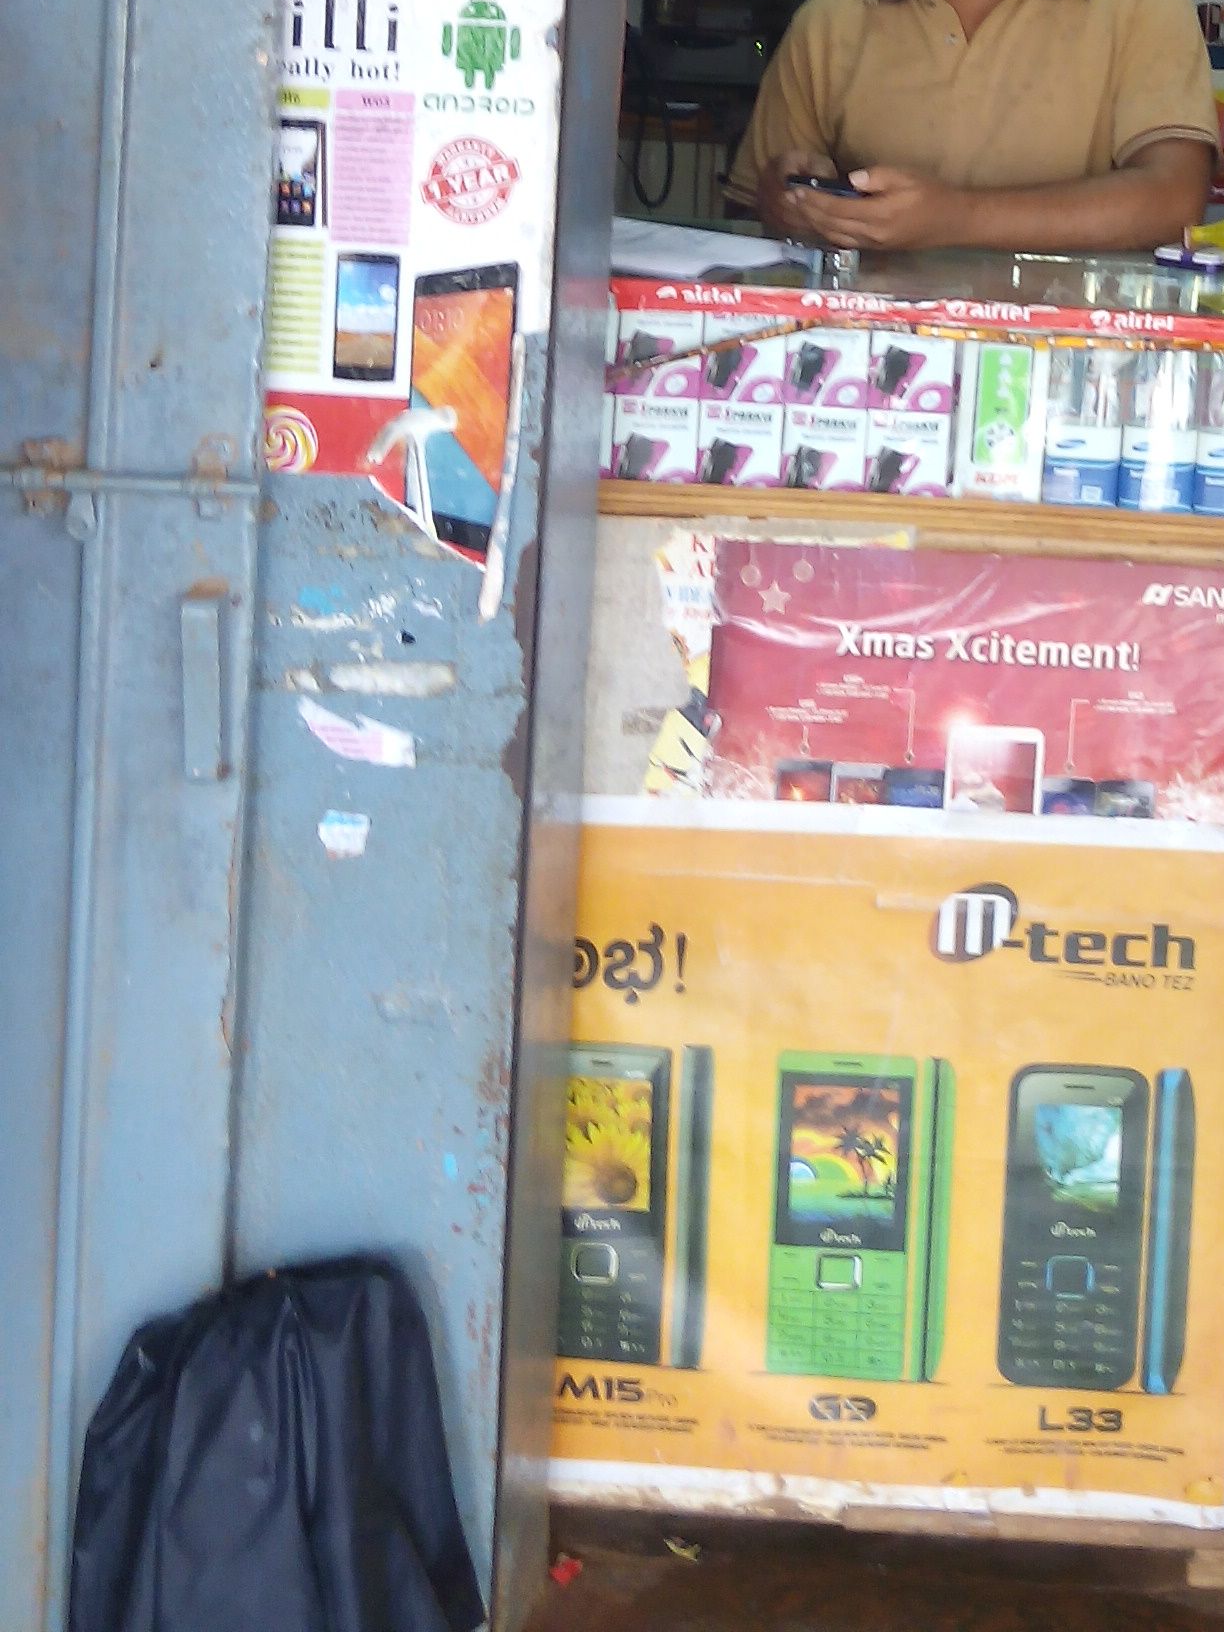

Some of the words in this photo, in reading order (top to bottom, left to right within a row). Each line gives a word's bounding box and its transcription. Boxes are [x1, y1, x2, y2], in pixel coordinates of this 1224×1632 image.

[350, 58, 400, 83] hot!
[446, 163, 512, 195] YEAR
[970, 301, 1031, 322] airtel
[1114, 308, 1175, 332] airtel
[835, 622, 935, 660] Xmas
[944, 630, 1141, 672] Xcitement!
[558, 1371, 645, 1403] M15
[1037, 1404, 1123, 1433] L33
